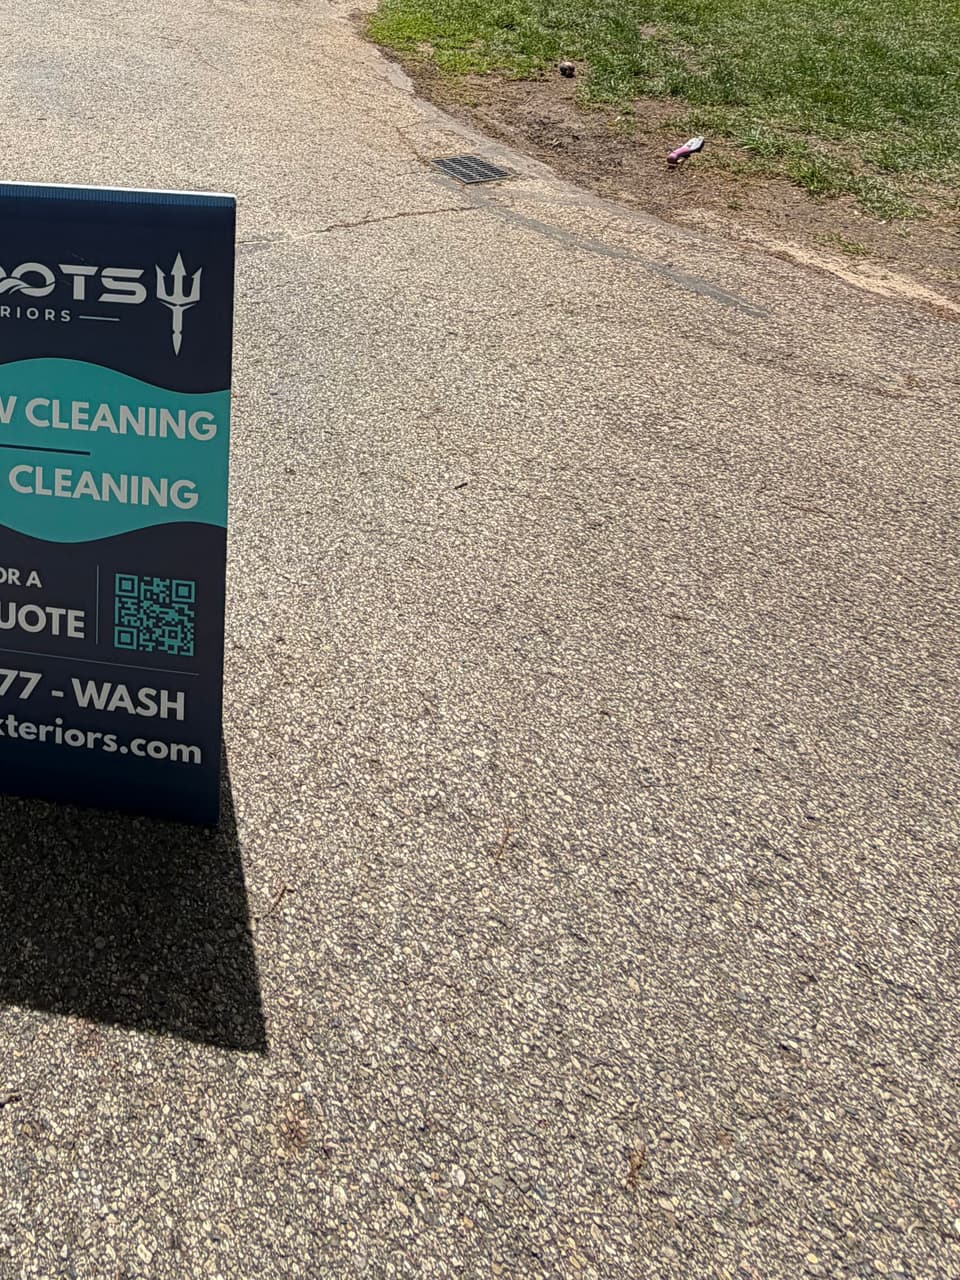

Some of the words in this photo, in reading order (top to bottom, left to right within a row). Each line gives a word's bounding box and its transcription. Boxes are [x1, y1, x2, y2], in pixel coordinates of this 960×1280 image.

[25, 398, 218, 441] CLEANING
[8, 465, 199, 509] CLEANING
[25, 570, 42, 588] A
[71, 677, 185, 721] WASH
